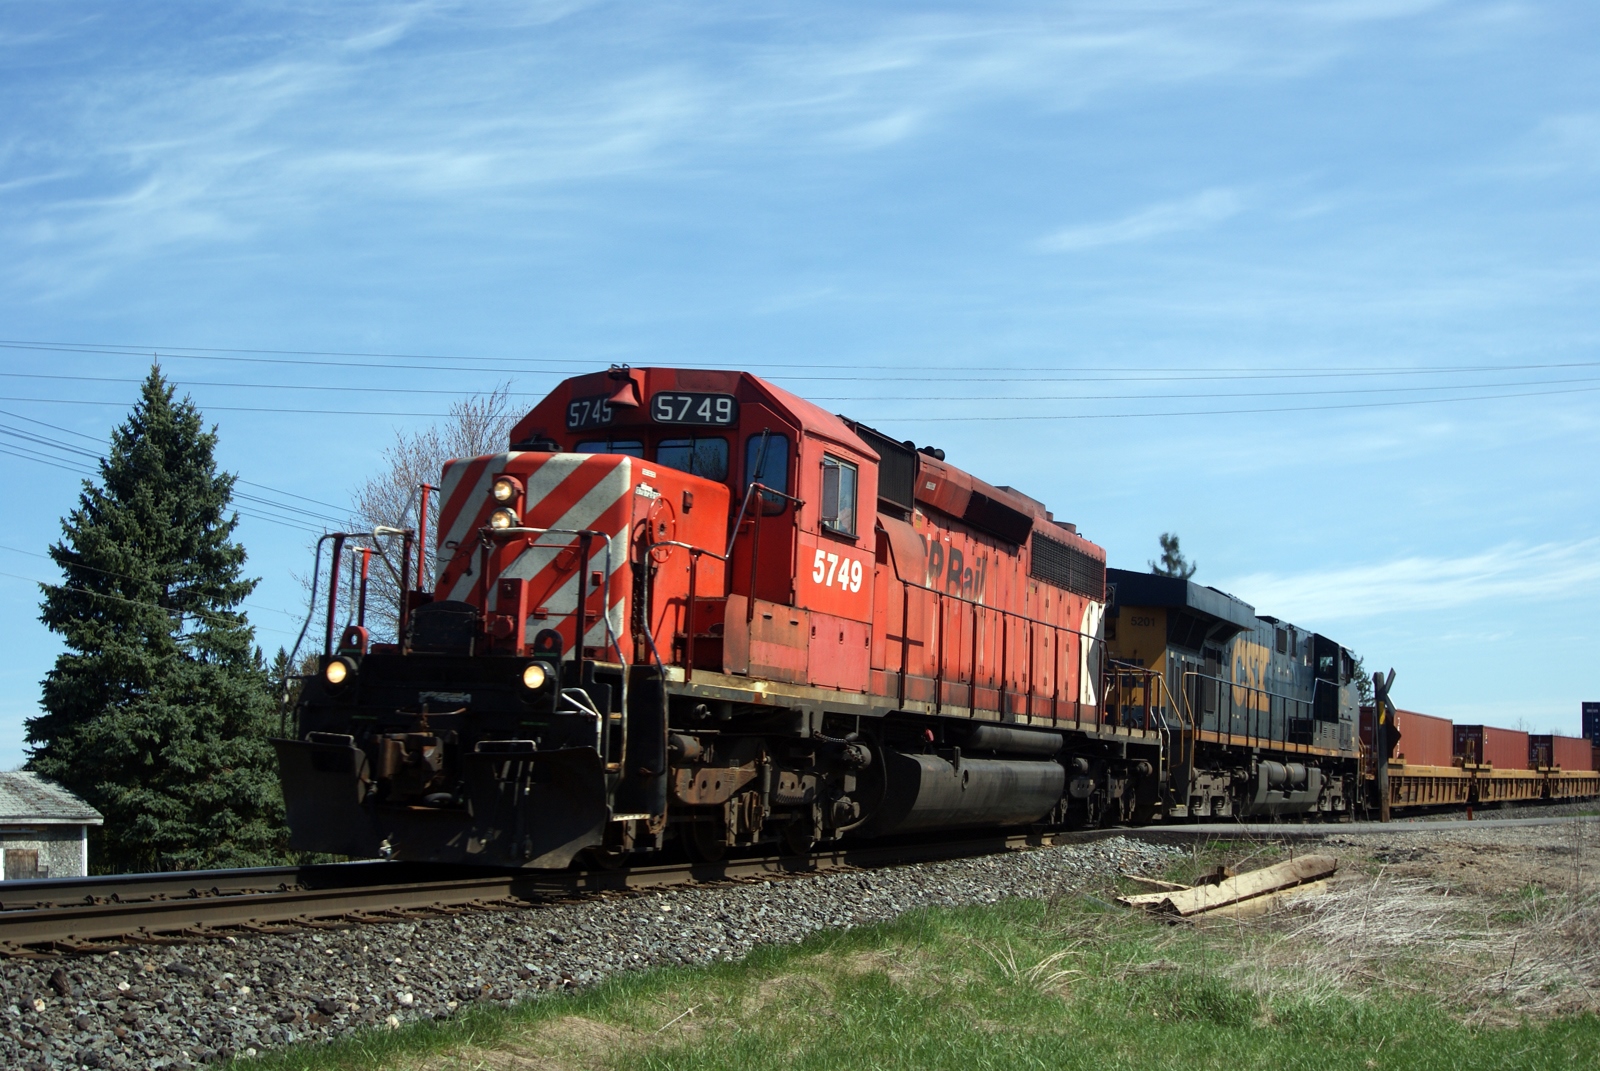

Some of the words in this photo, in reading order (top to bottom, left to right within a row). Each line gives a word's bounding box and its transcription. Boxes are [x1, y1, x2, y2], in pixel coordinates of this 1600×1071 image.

[657, 395, 732, 423] 5749
[812, 548, 863, 593] 5749
[945, 546, 987, 598] Rail
[1130, 616, 1155, 627] 5201
[1231, 637, 1270, 712] CSX
